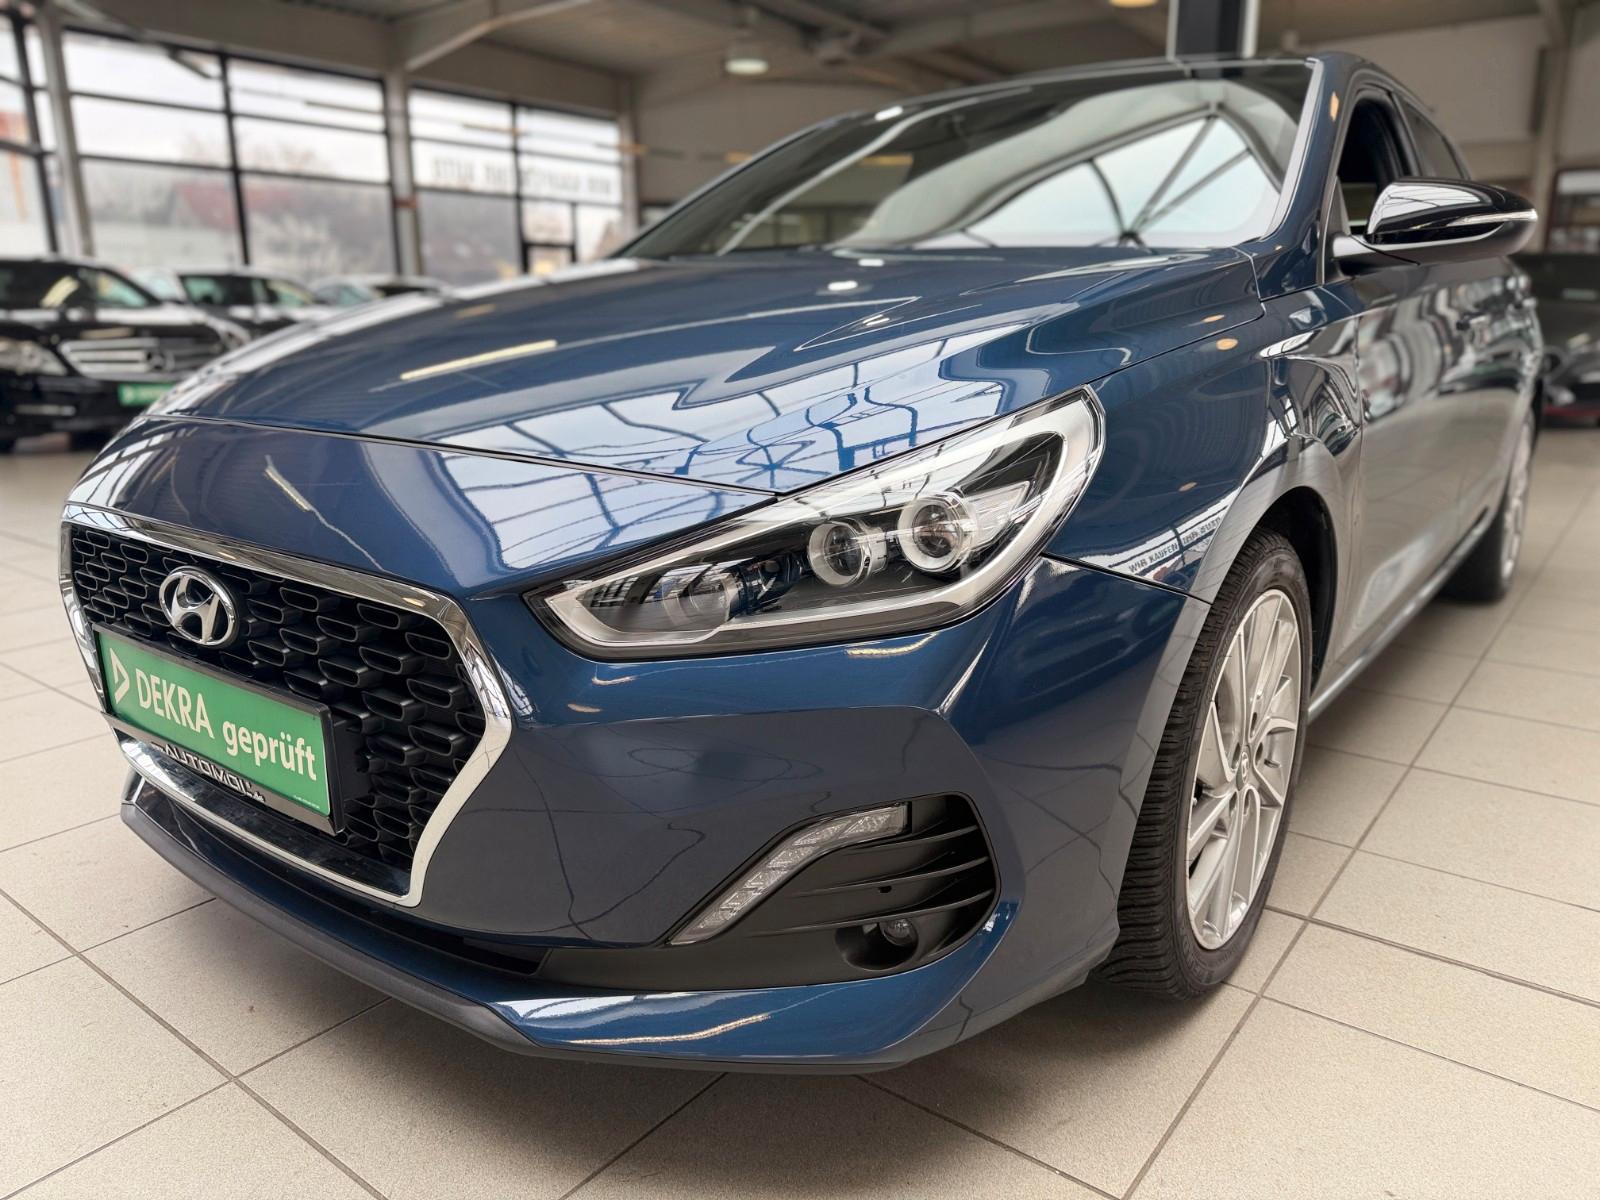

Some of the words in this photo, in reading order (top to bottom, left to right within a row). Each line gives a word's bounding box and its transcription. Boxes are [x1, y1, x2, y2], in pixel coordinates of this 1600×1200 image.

[1148, 543, 1178, 563] KAUFEN
[135, 668, 215, 740] DEKRA
[222, 719, 317, 781] geprüft
